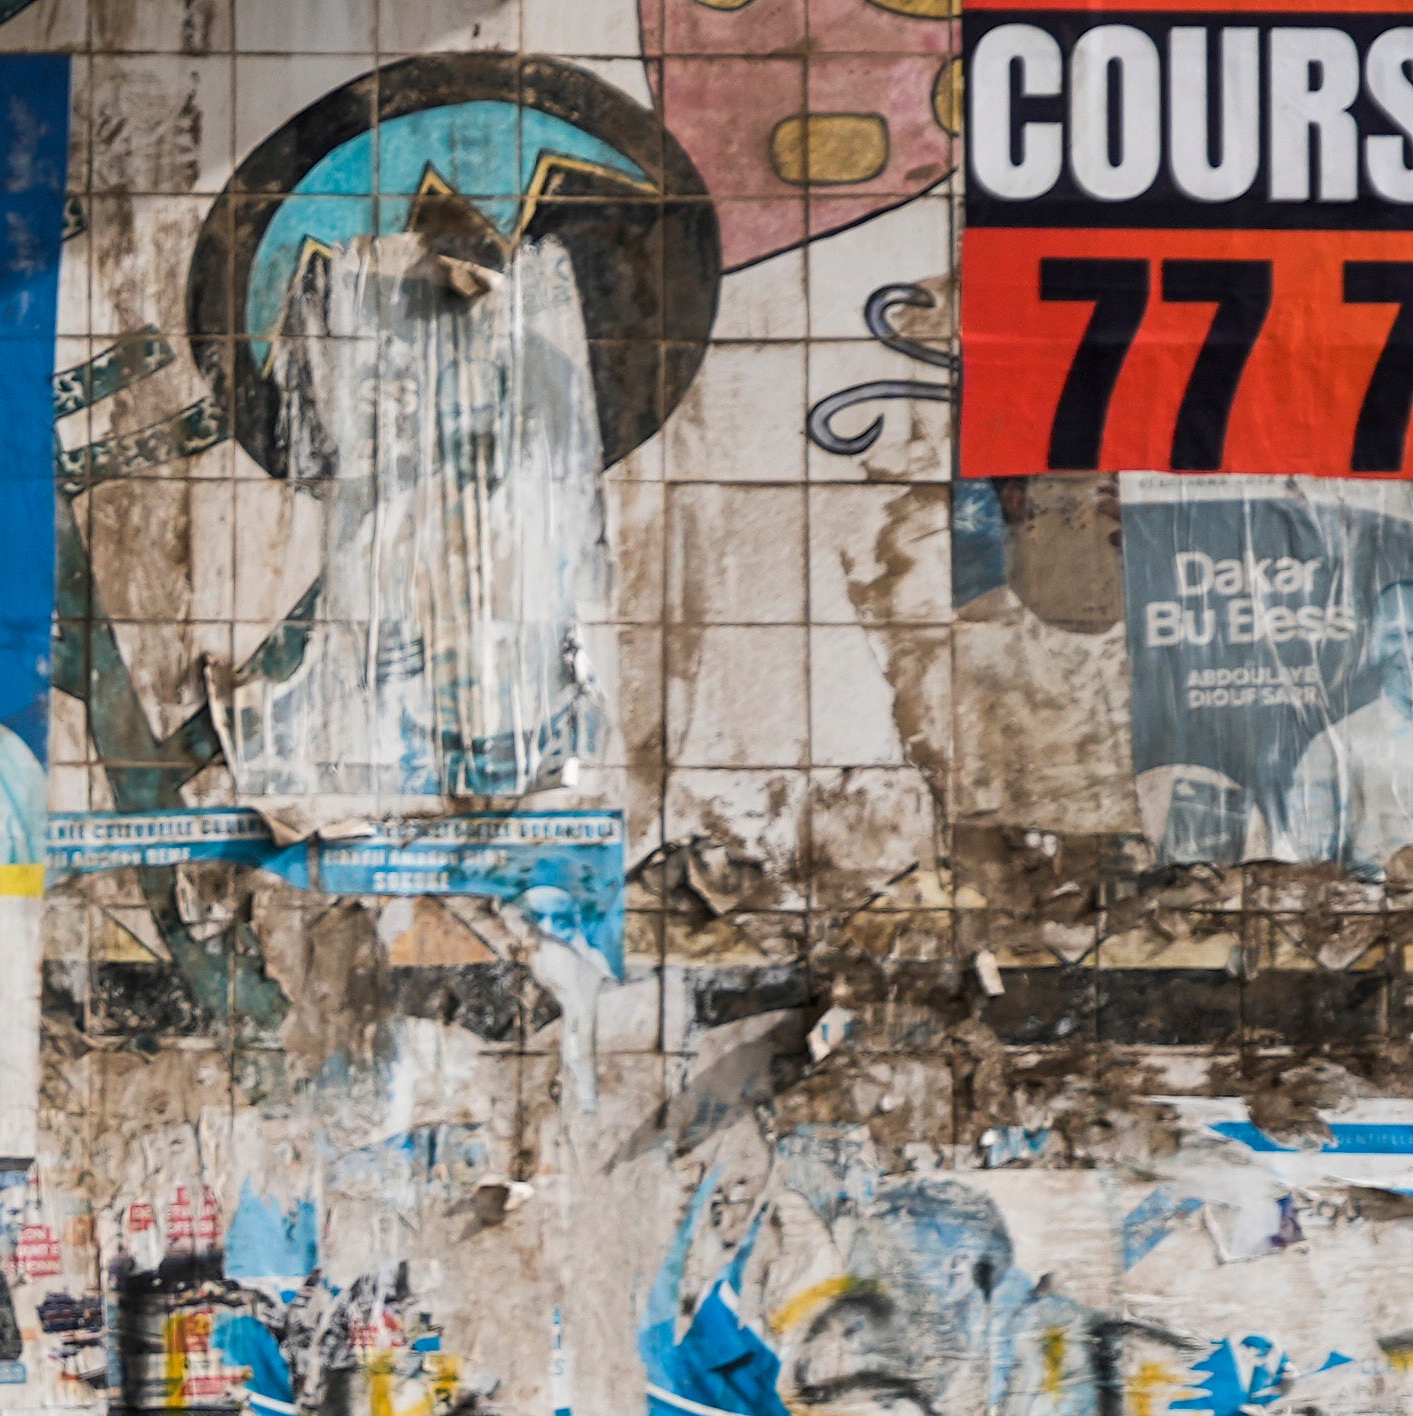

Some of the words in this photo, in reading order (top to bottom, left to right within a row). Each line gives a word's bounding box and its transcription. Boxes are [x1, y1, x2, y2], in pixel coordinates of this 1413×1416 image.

[972, 22, 1413, 202] COURS
[1039, 256, 1272, 471] 77
[1175, 550, 1324, 598] Dakar
[1146, 600, 1216, 648] Bu
[1227, 599, 1359, 645] Bess
[1187, 665, 1319, 688] ABDOULAYE
